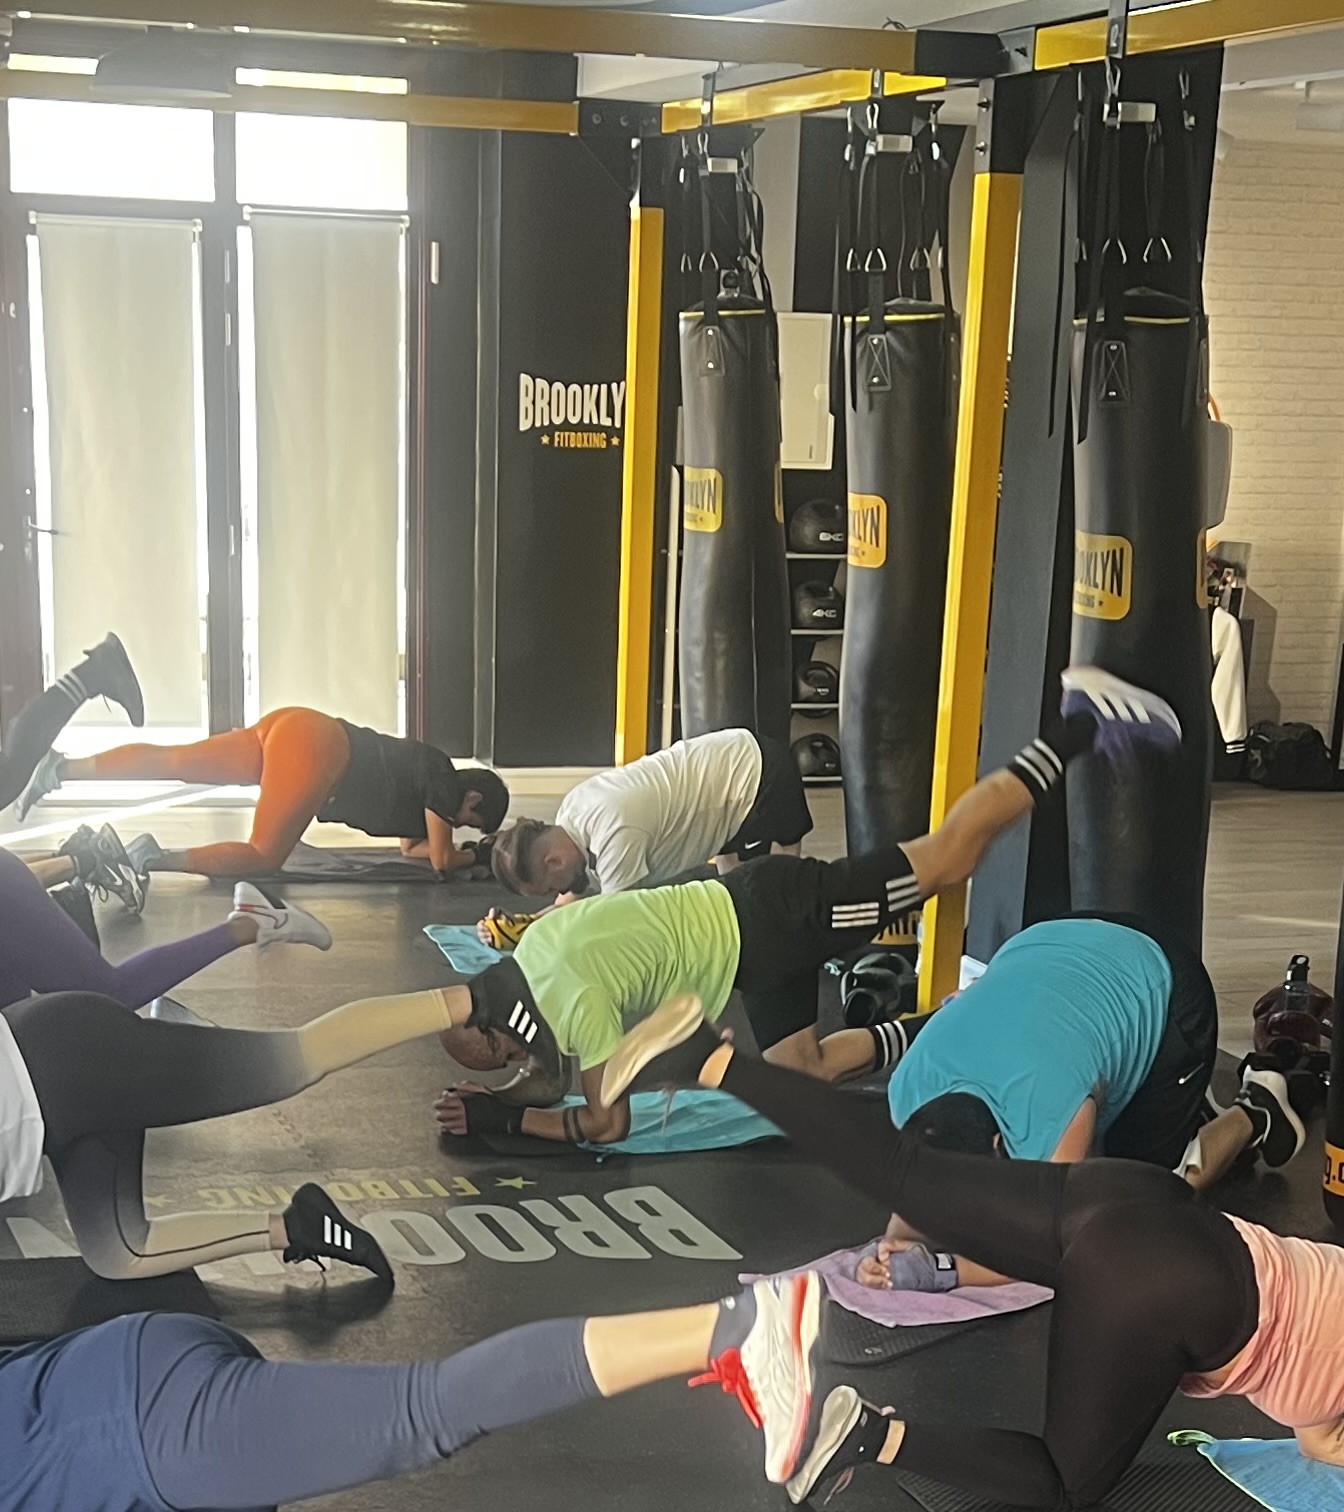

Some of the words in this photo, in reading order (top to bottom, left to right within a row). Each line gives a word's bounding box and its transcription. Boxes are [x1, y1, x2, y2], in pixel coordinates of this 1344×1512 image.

[519, 372, 626, 431] BROOKLY
[554, 431, 607, 448] FITBOXING
[196, 1176, 481, 1208] FITBOING
